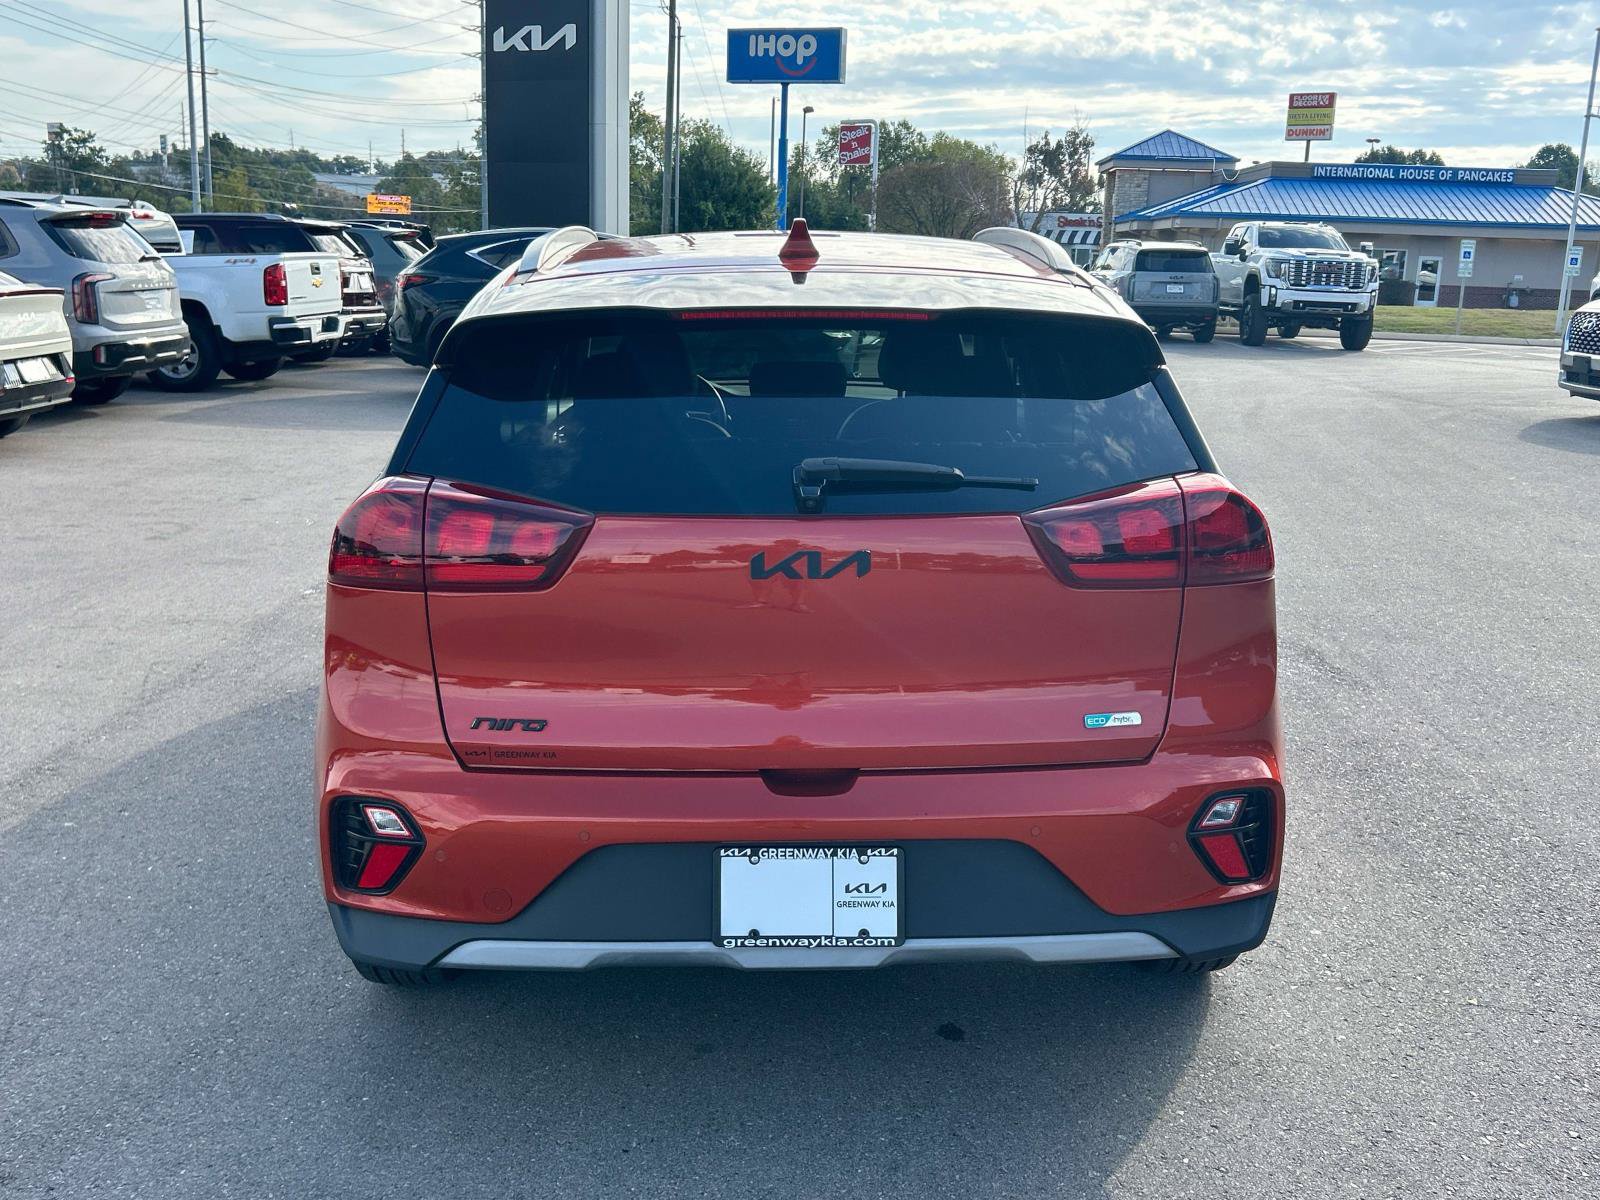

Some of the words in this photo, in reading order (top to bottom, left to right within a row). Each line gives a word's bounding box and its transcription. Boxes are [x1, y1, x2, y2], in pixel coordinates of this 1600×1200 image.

[493, 23, 577, 52] KIA
[840, 125, 869, 144] Steak
[839, 146, 871, 164] Shake
[1314, 166, 1395, 179] INTERNATIONAL
[1399, 169, 1435, 180] HOUSE
[1439, 170, 1453, 181] OF
[1457, 171, 1514, 182] PANCAKES
[750, 549, 872, 580] KIA
[1087, 717, 1106, 725] ECO
[494, 751, 541, 759] GREENWAY
[720, 848, 752, 857] KIA
[758, 848, 834, 860] GREENWAY
[837, 848, 858, 860] KIA
[867, 848, 898, 857] KIA
[845, 882, 887, 894] KIA
[836, 900, 881, 908] GREENWAY
[882, 900, 895, 908] KIA
[723, 936, 896, 949] greenwaykia.com
